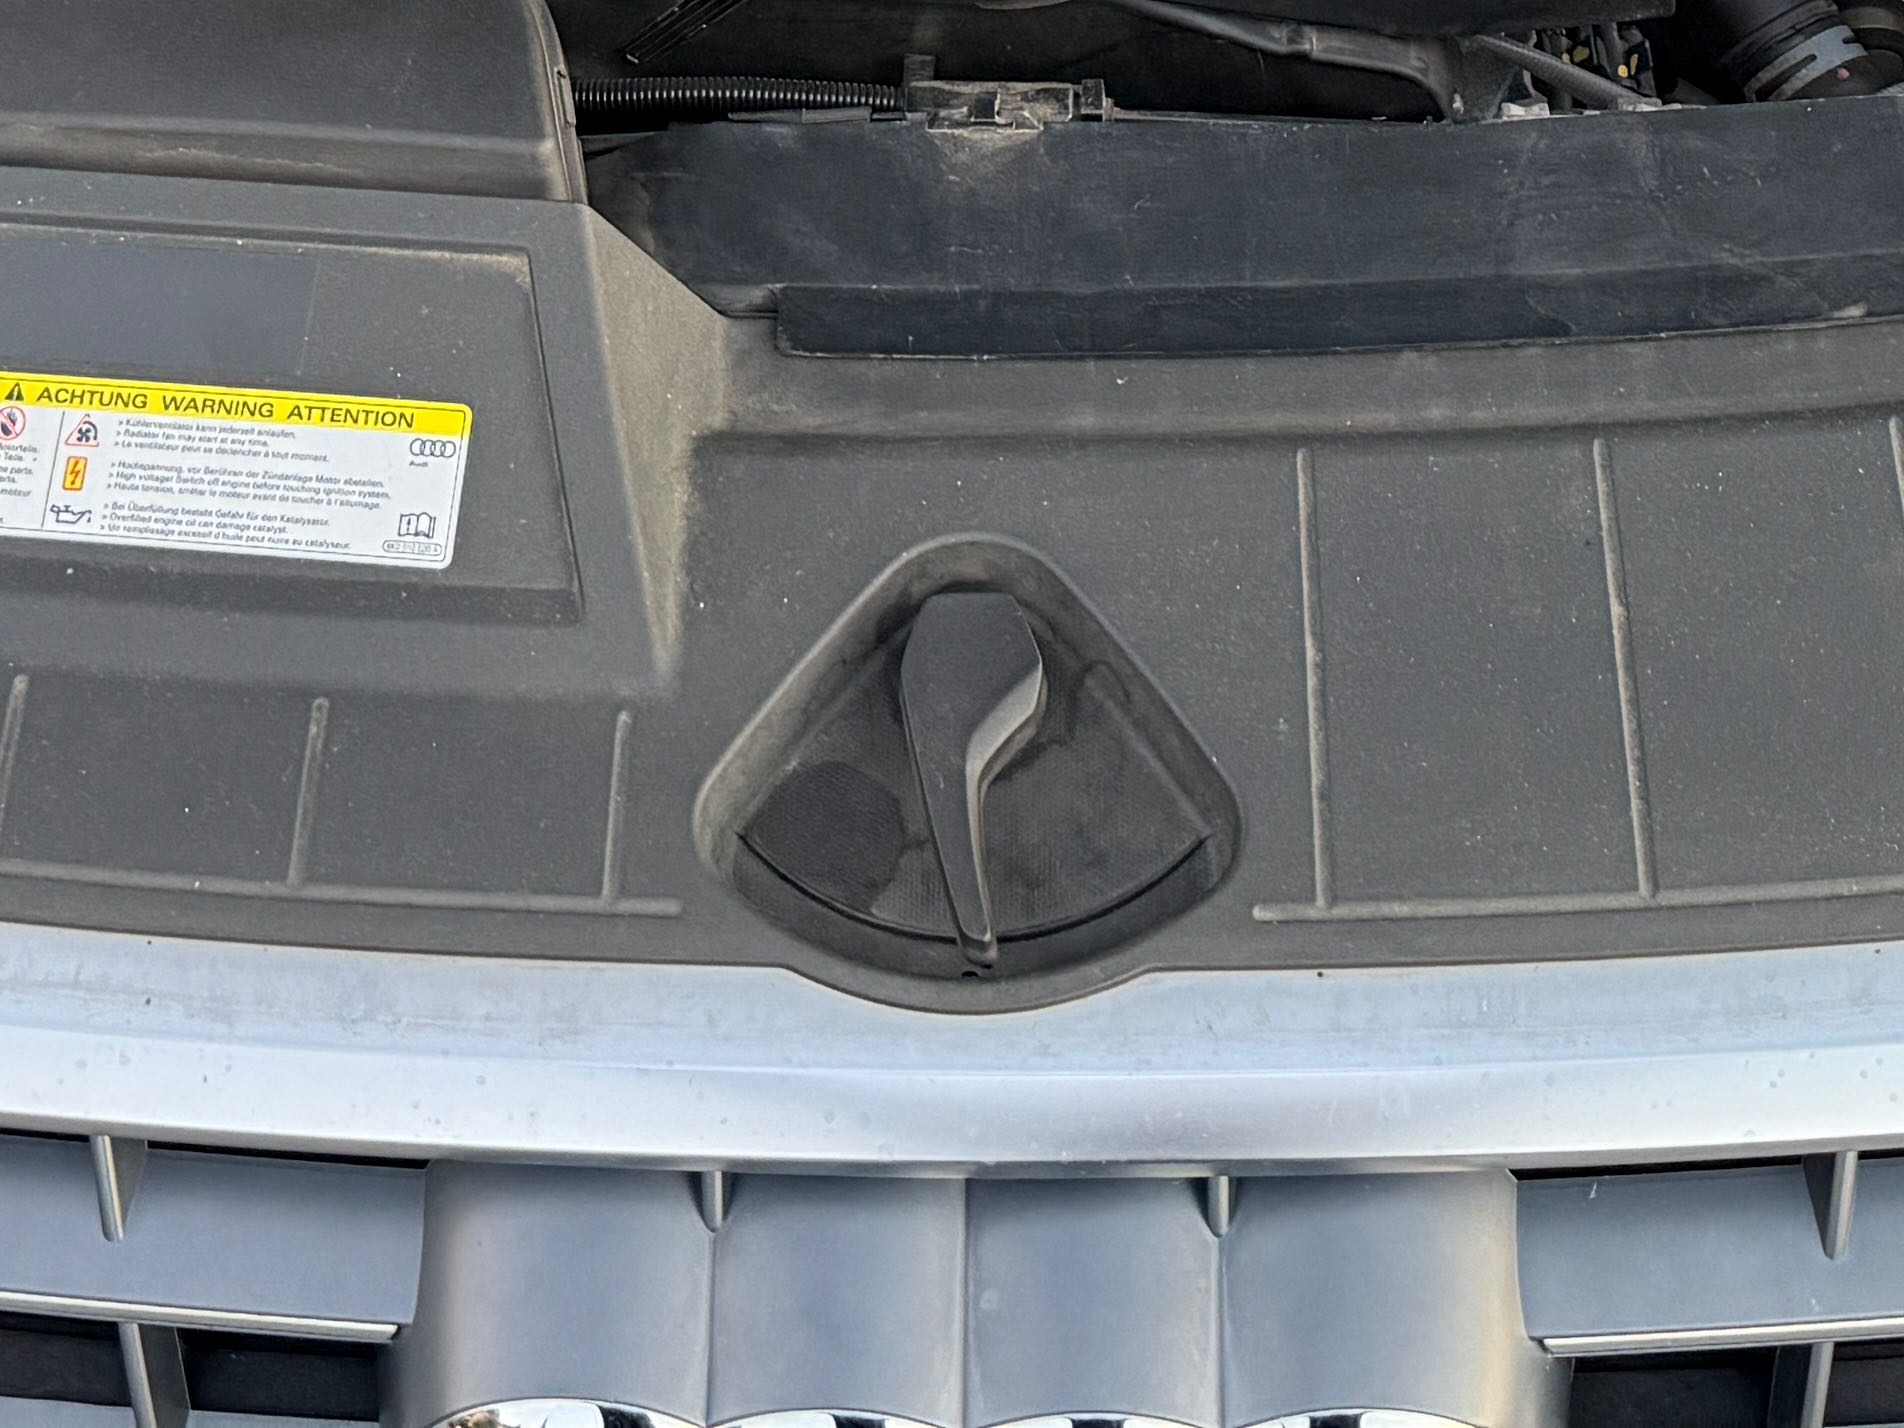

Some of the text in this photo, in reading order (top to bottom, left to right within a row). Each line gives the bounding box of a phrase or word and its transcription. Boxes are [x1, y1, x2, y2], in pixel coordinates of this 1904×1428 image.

[36, 388, 414, 428] ACHTUNG WARNING ATTENTION
